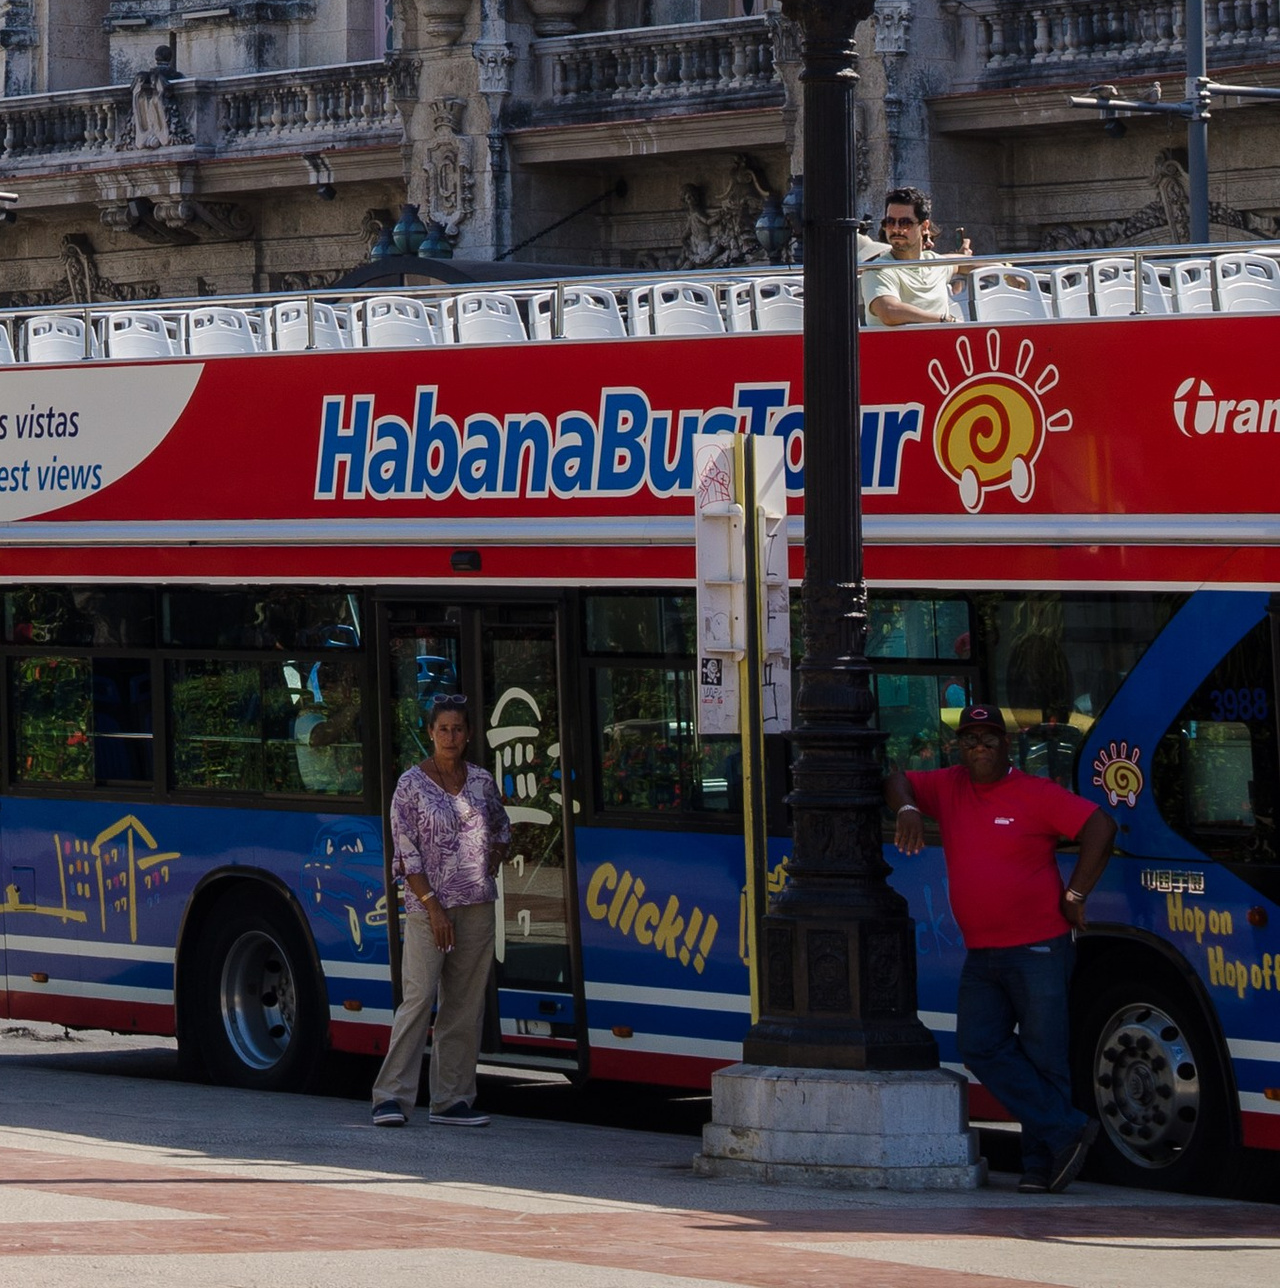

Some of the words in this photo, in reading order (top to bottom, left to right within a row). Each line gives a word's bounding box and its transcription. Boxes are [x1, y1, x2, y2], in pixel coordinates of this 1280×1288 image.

[15, 404, 80, 439] vistas
[313, 380, 926, 502] HabanaBuTor
[37, 455, 102, 491] views
[1210, 686, 1269, 721] 3988
[586, 861, 719, 975] Click!!
[1166, 892, 1206, 944] Hop
[1209, 909, 1232, 935] on
[1207, 945, 1248, 999] Hop
